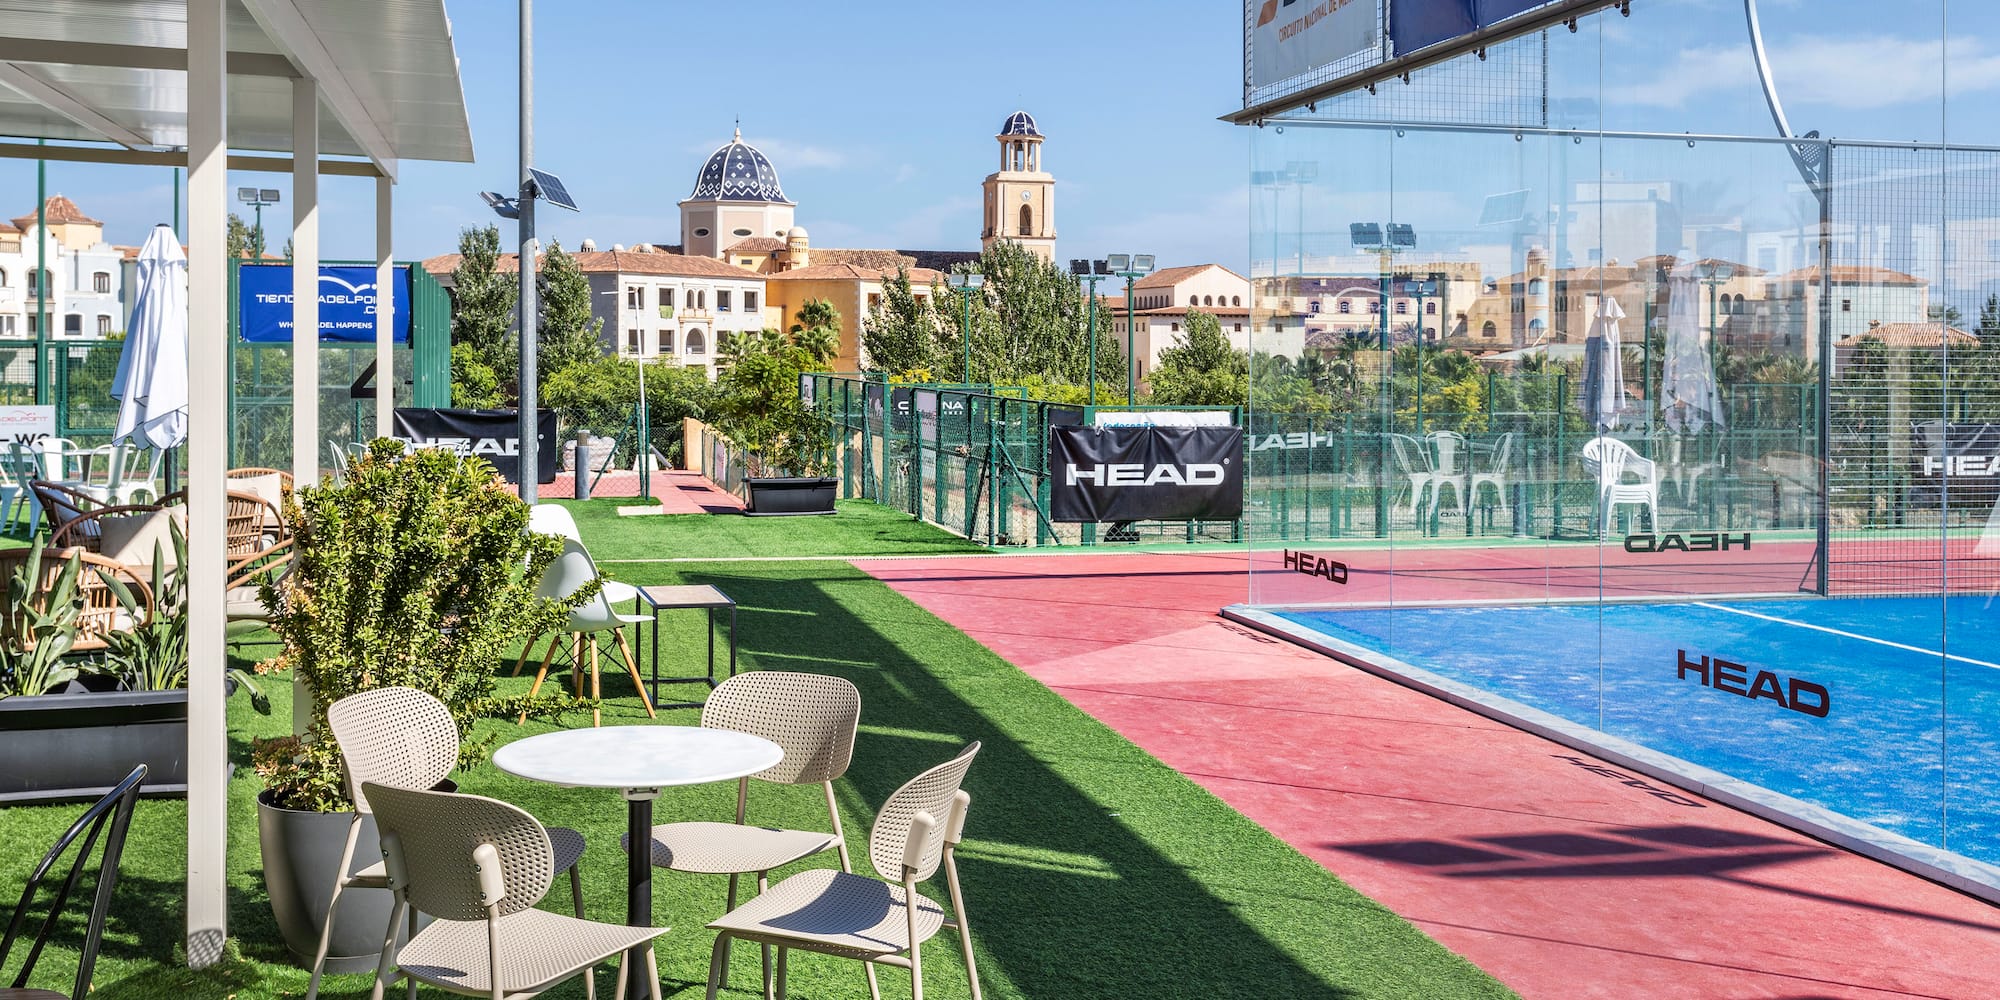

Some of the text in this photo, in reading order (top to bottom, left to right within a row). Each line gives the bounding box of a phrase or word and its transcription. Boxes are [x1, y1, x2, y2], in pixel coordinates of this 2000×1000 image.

[256, 294, 395, 304] TIENDADELPOI
[1066, 463, 1225, 487] HEAD
[1284, 548, 1348, 585] HEAD
[1677, 649, 1830, 718] HEAD
